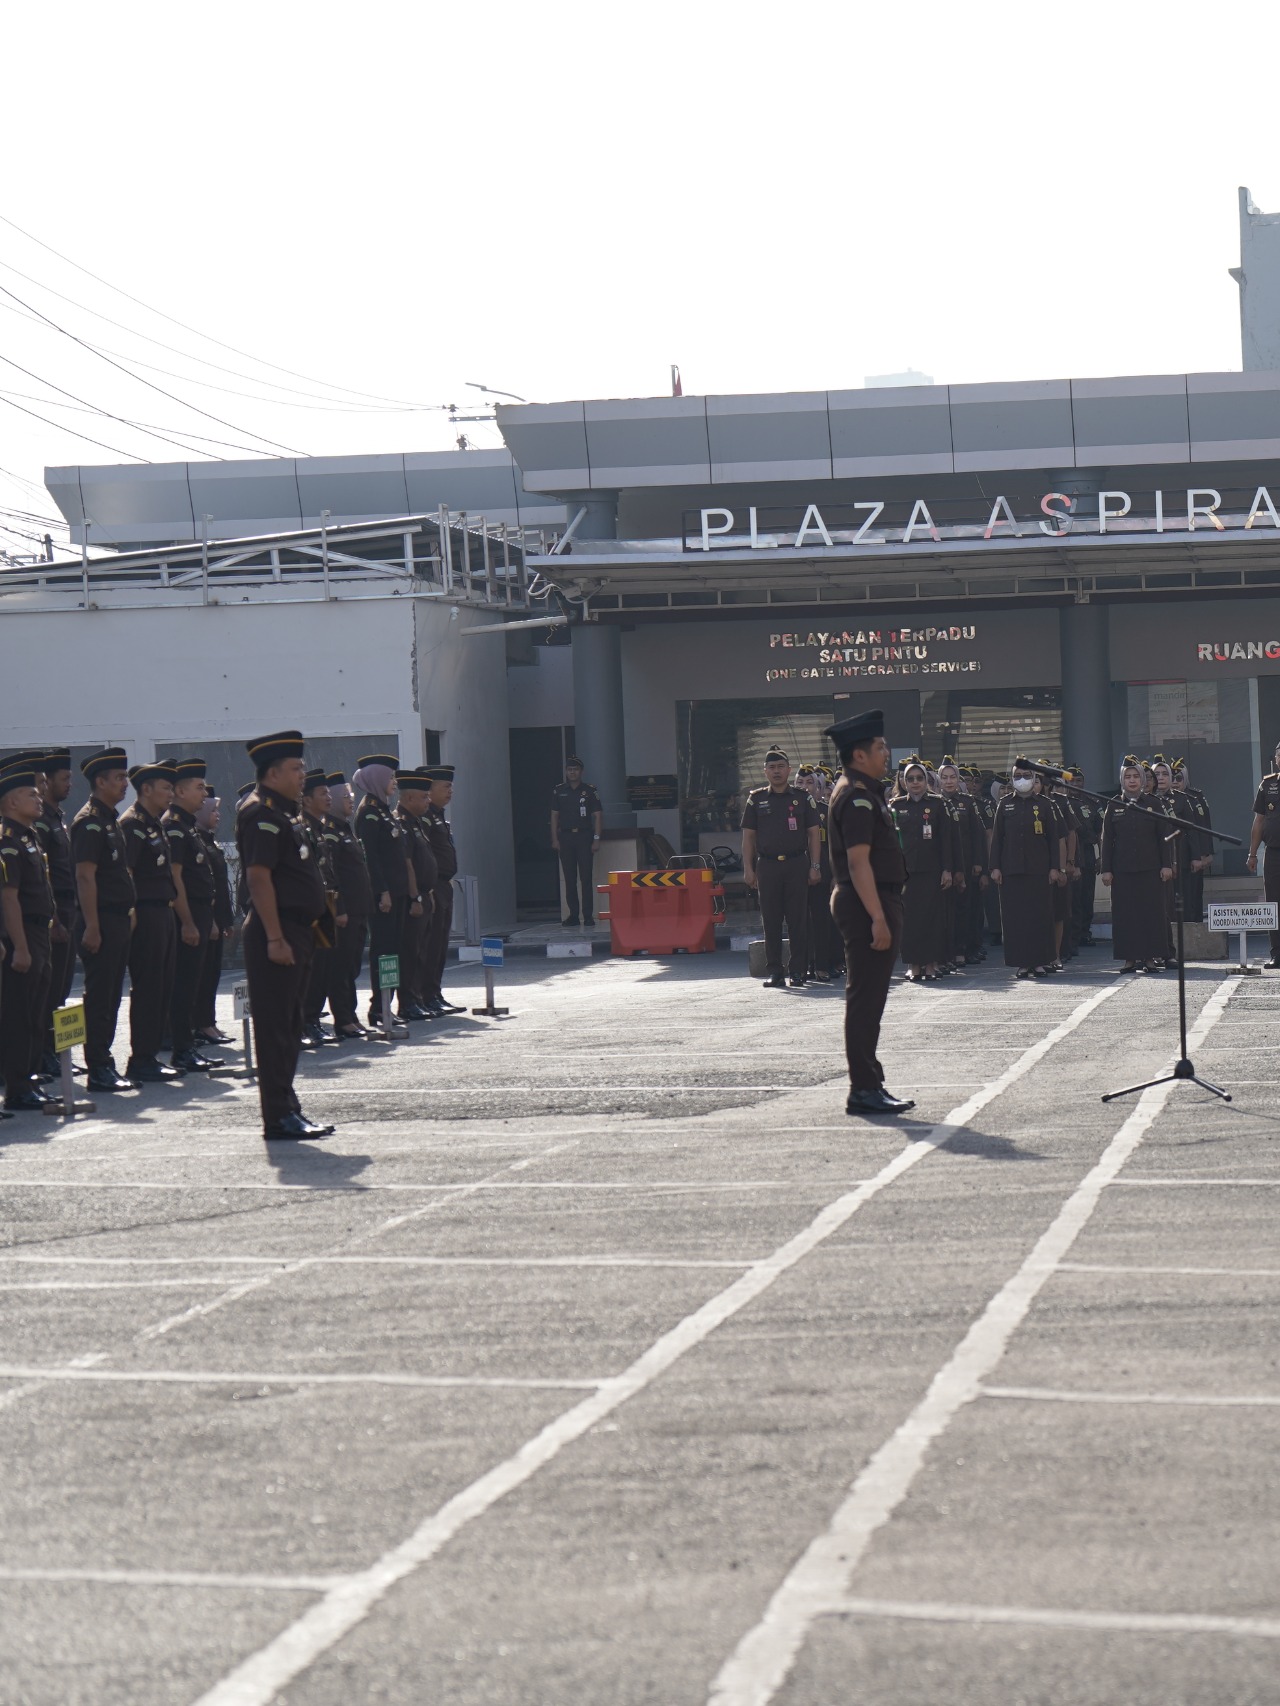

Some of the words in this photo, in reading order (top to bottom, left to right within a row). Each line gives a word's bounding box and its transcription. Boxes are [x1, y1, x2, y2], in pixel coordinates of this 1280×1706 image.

[700, 499, 942, 551] PLAZA
[769, 630, 882, 648] PELAYANAN
[888, 625, 977, 643] TERPADU
[819, 649, 867, 664] SATU
[871, 645, 928, 661] PINTU
[766, 668, 797, 682] (ONE
[801, 668, 835, 679] GATE
[838, 663, 919, 678] INTEGRATED
[921, 661, 982, 674] SERVICE)
[1213, 909, 1240, 917] ASISTEN,
[1241, 908, 1262, 916] KABAG
[1263, 908, 1273, 916] TU,
[1255, 918, 1273, 926] SENIOR
